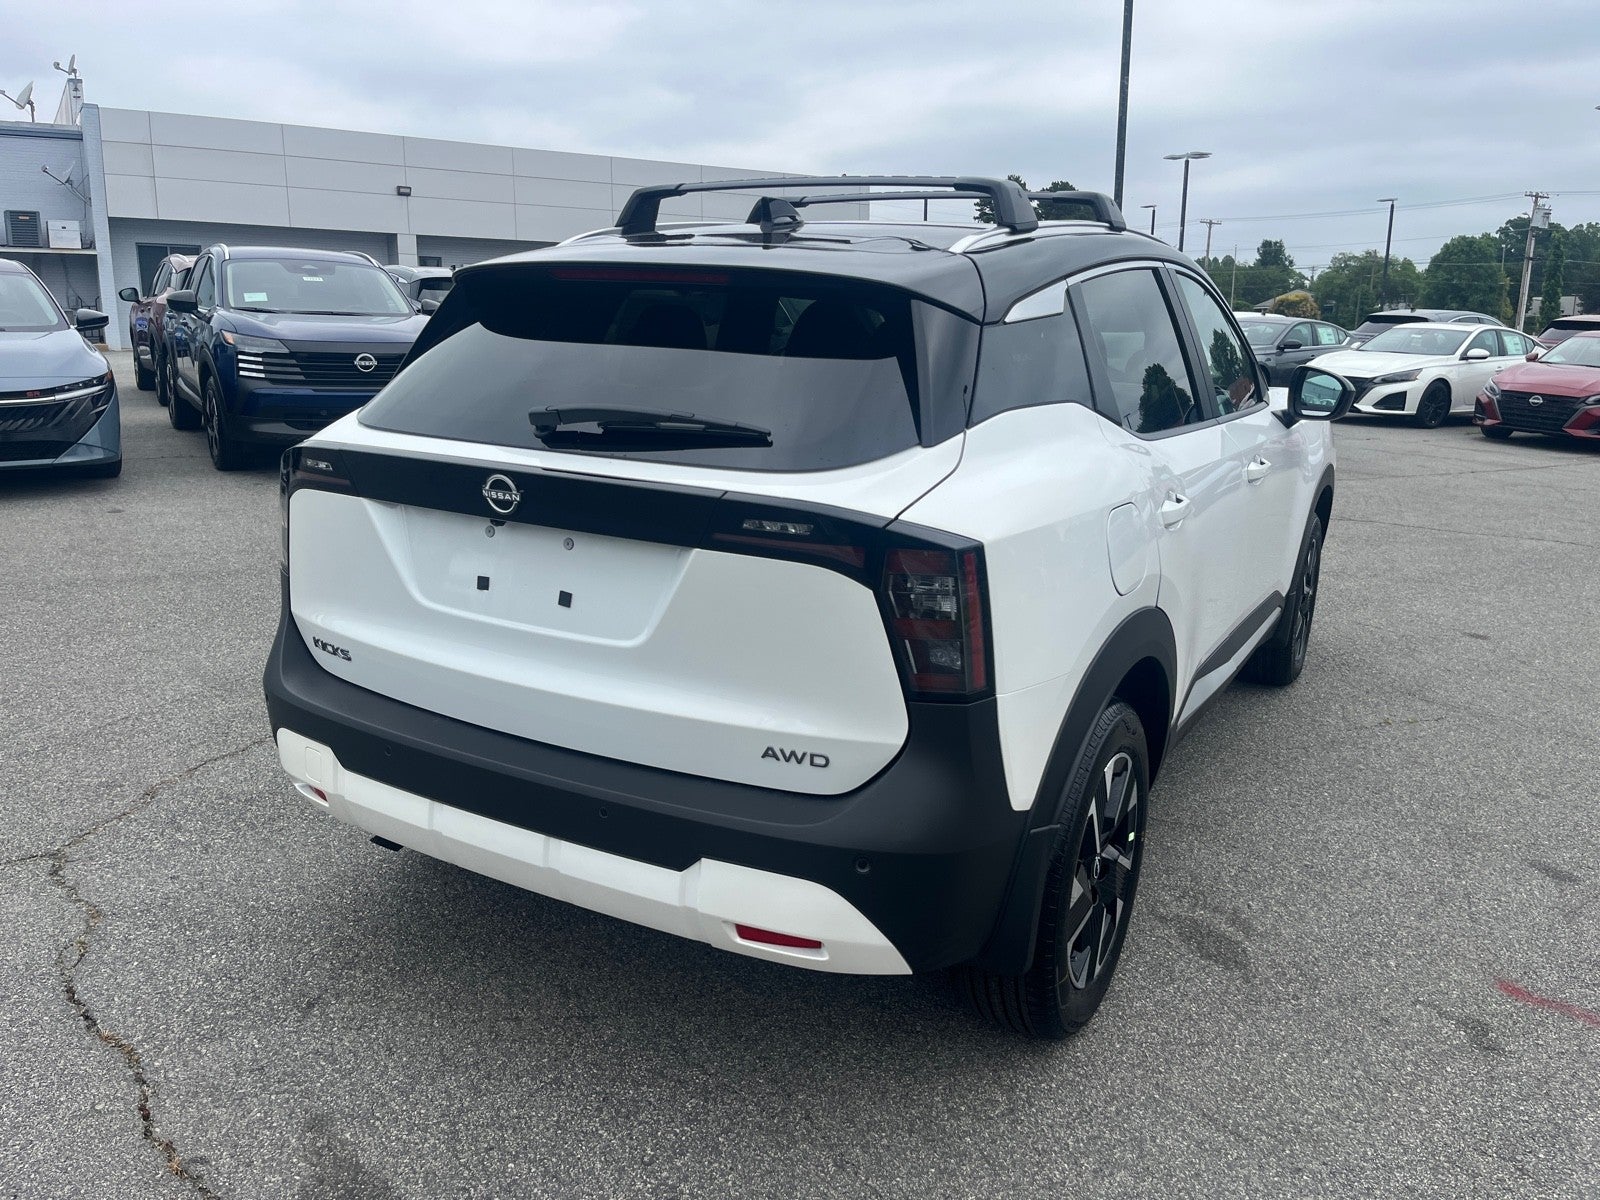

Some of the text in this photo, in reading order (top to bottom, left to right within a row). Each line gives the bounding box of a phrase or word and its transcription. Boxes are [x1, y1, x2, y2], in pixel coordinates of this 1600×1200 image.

[482, 489, 520, 501] NISSAN
[312, 636, 352, 661] KICKS
[761, 746, 830, 768] AWD
